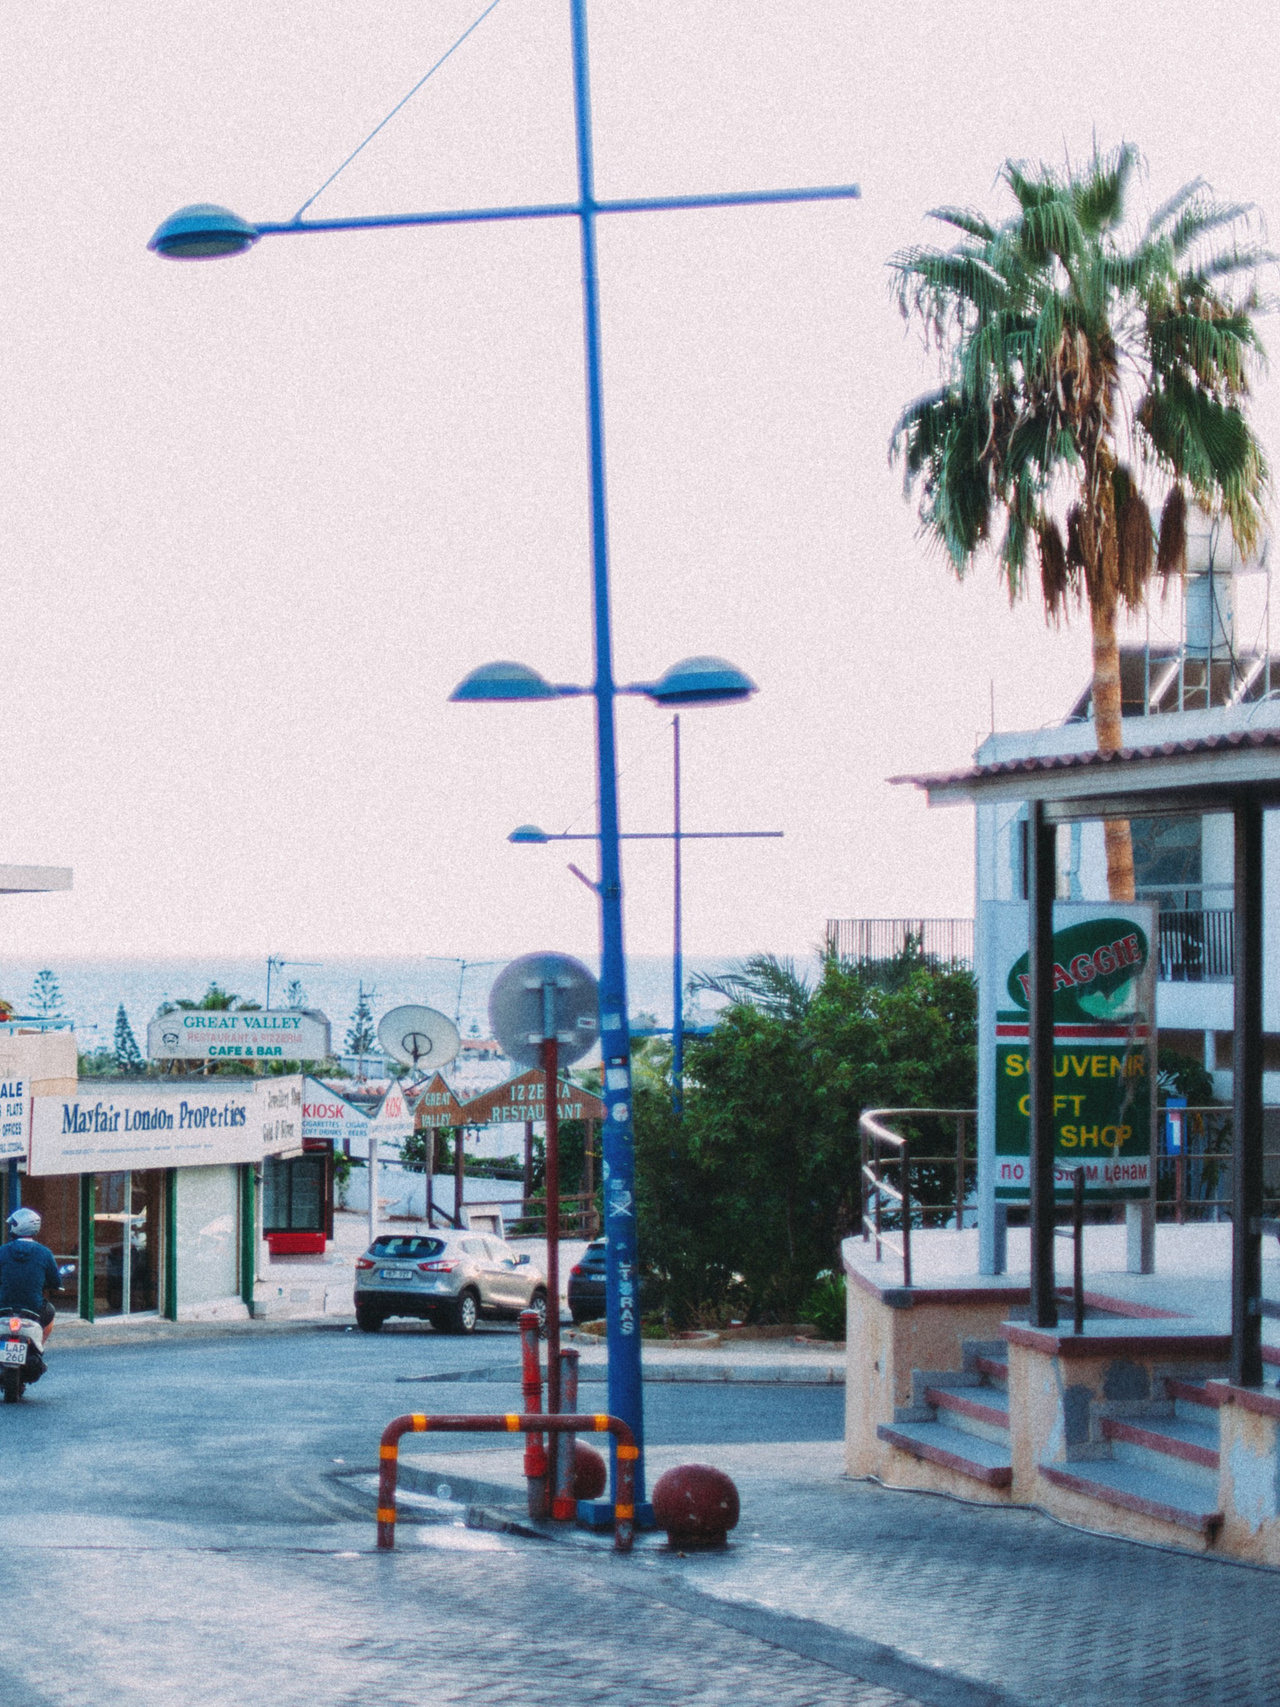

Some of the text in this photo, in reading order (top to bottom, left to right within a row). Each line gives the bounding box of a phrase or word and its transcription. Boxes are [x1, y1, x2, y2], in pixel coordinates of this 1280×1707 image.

[183, 1016, 302, 1030] GREAT VALLEY
[208, 1046, 283, 1056] CAFE & BAR
[1005, 1053, 1146, 1078] SUVENIR
[425, 1091, 452, 1107] GREAT
[6, 1102, 23, 1117] FLATS
[61, 1099, 247, 1134] Mayfair London Properties
[302, 1103, 346, 1119] KIOSK
[491, 1103, 583, 1122] RESTAUANT
[1059, 1124, 1133, 1148] SHOP
